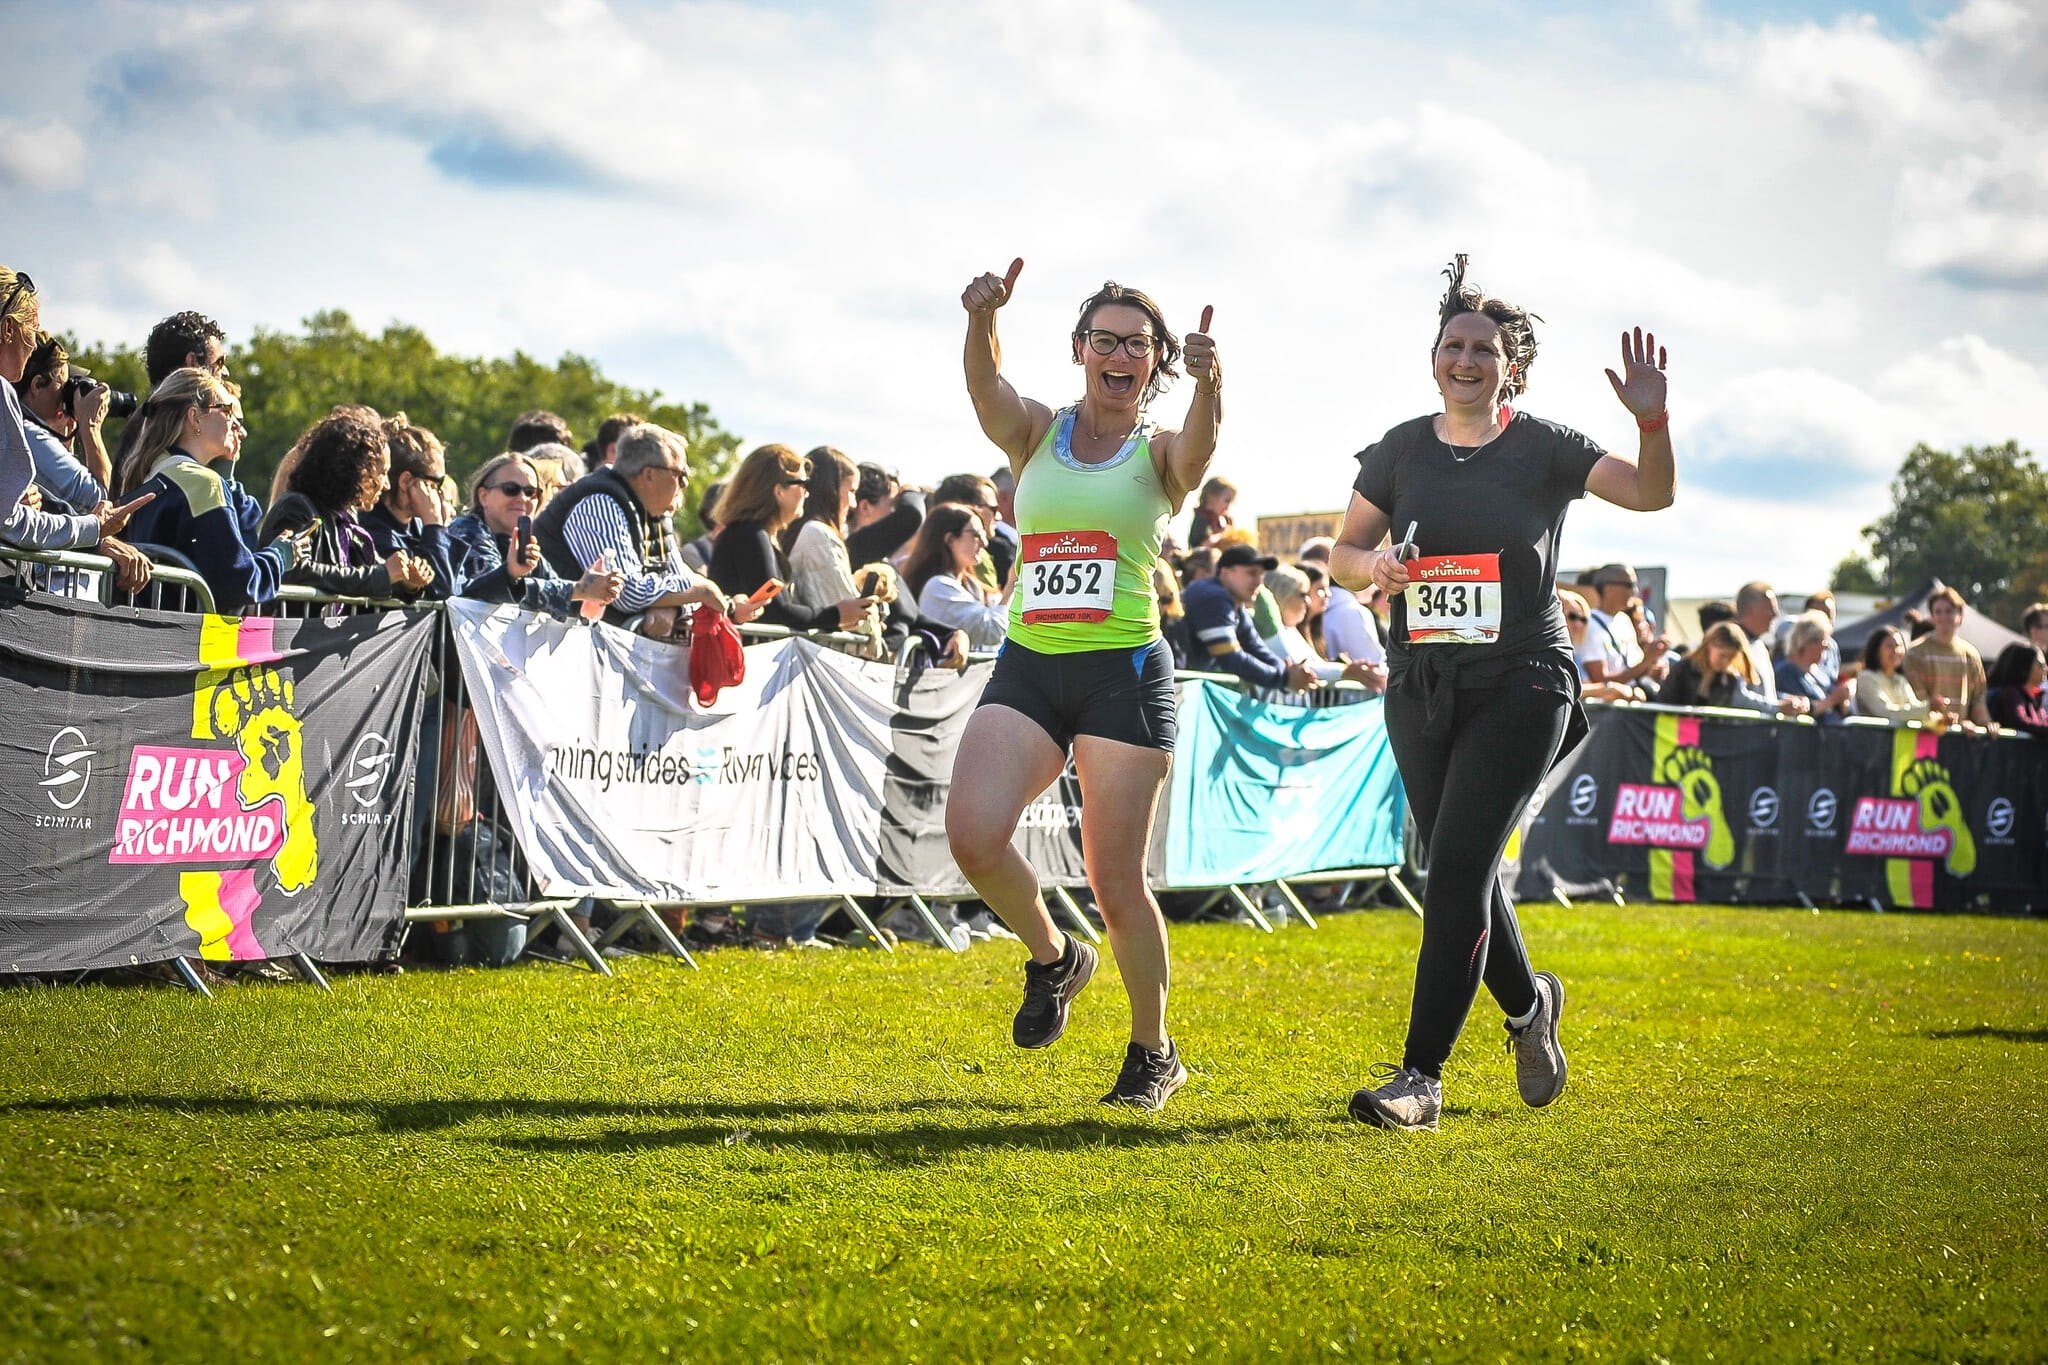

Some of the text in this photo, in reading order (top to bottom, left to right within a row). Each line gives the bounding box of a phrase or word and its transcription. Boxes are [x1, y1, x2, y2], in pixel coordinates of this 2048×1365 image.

[1040, 543, 1098, 557] gofundme
[1033, 562, 1102, 597] 3652
[1420, 566, 1480, 579] gofundme
[1417, 584, 1482, 618] 3431
[1035, 612, 1076, 621] RICHMOND
[126, 754, 231, 811] RUN
[1616, 787, 1676, 819] RUN
[1855, 800, 1913, 831] RUN
[35, 814, 92, 830] SCIMITAR
[115, 815, 275, 856] RICHMOND
[1612, 819, 1706, 843] RICHMOND
[1850, 831, 1948, 854] RICHMOND
